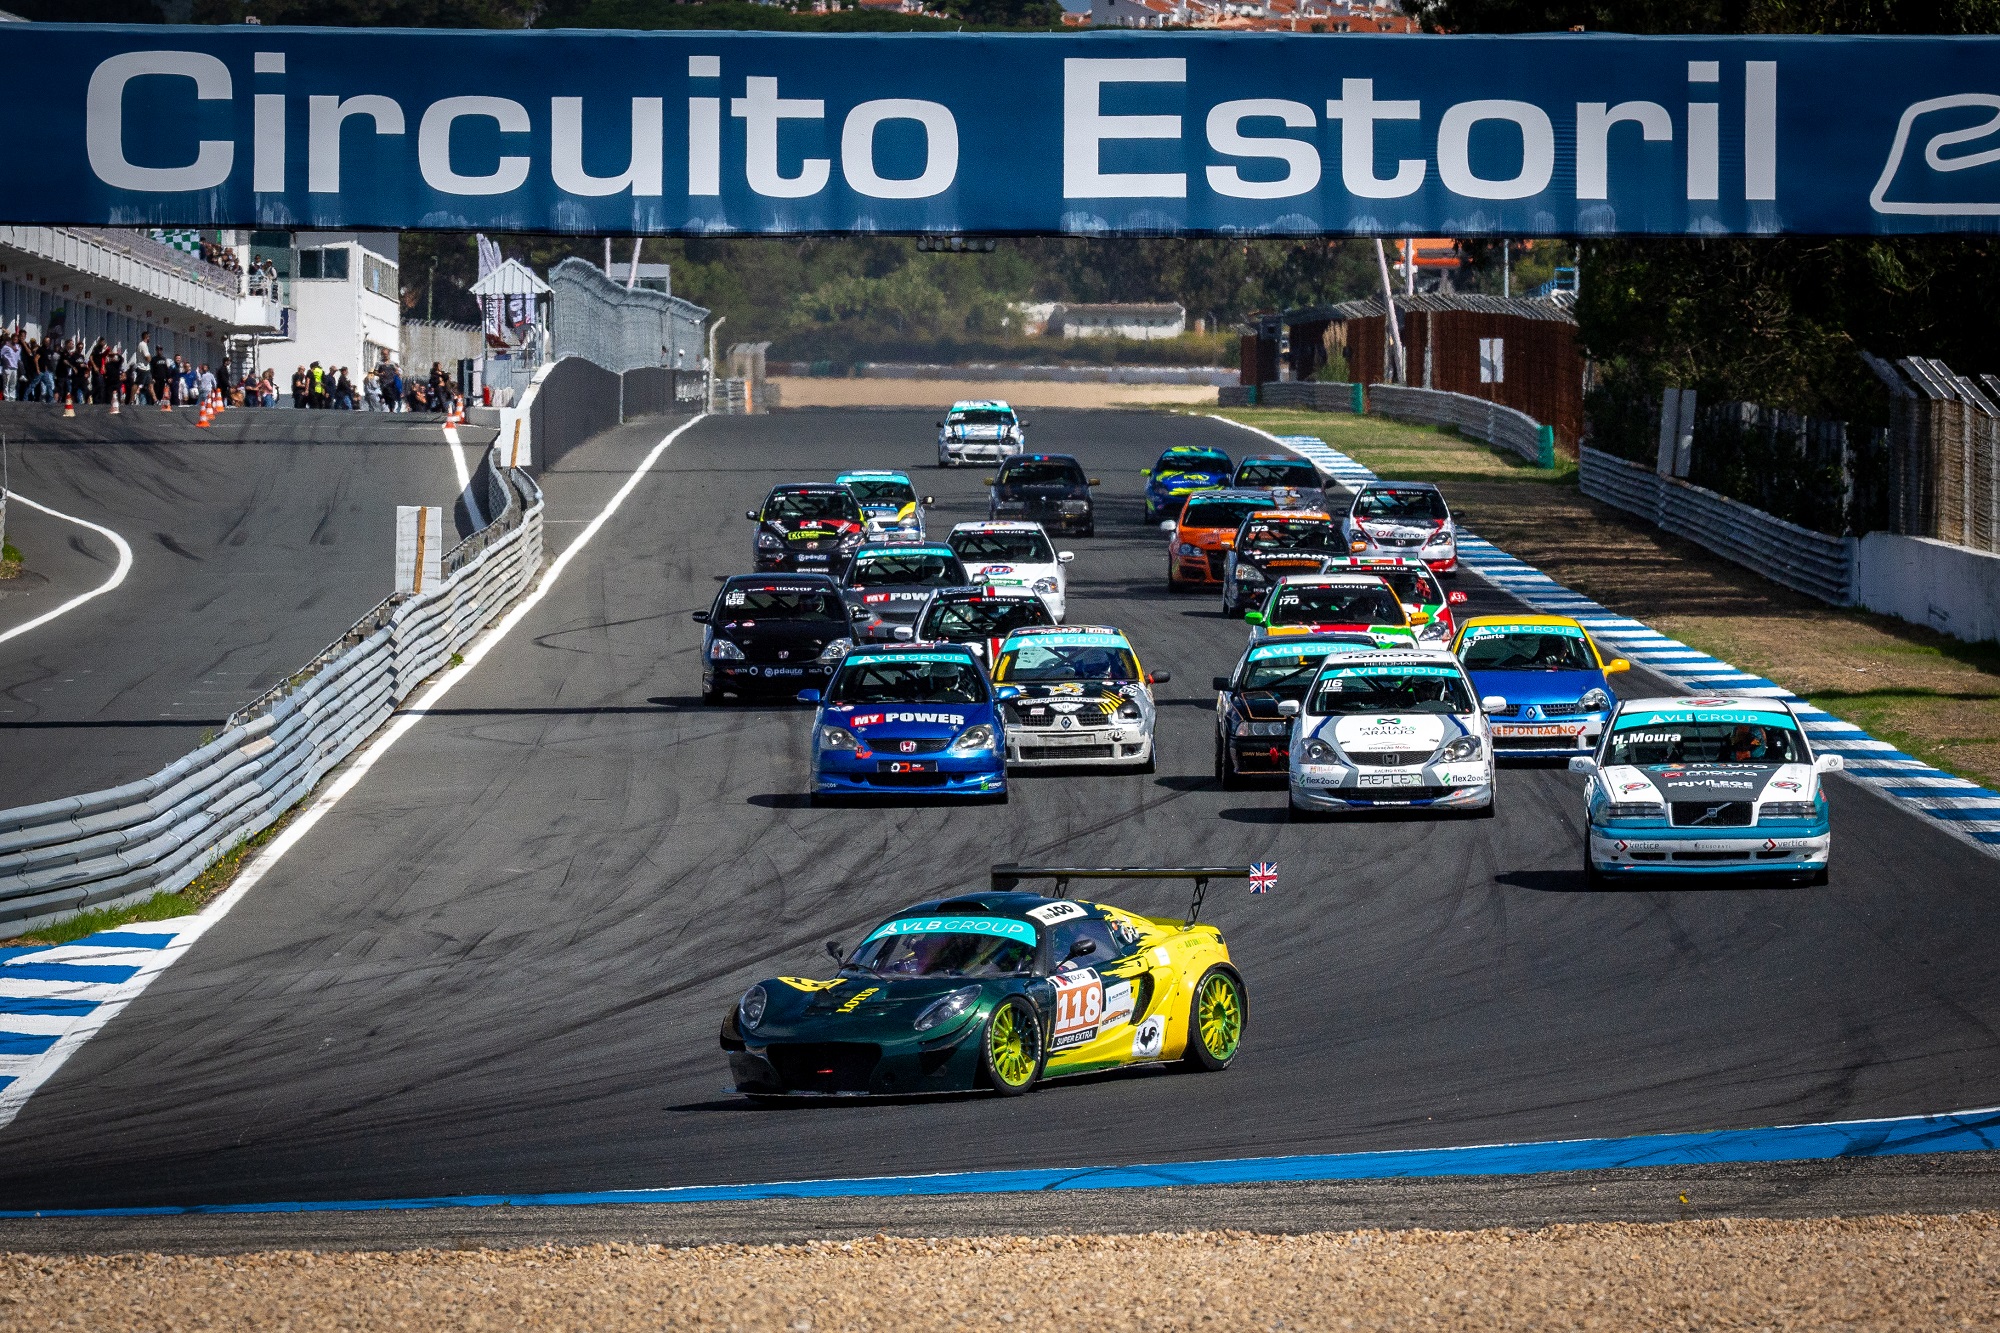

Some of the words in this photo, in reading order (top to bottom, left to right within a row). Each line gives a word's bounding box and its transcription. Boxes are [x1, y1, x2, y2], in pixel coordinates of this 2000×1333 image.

[87, 51, 958, 198] Circuito
[1064, 58, 1776, 199] Estoril
[726, 598, 744, 606] 166
[1279, 597, 1299, 605] 170
[1491, 625, 1520, 633] VLB
[1522, 626, 1576, 634] GROUP
[1035, 637, 1064, 645] VLB
[1066, 636, 1120, 645] GROUP
[1473, 633, 1506, 641] Duarte
[1272, 647, 1302, 655] VLB
[1322, 679, 1343, 688] 116
[854, 714, 880, 726] MY
[885, 712, 964, 725] POWER
[1697, 713, 1758, 723] GROUP
[1491, 726, 1514, 735] KEEP
[1517, 726, 1533, 735] ON
[1537, 725, 1577, 735] RACING
[1612, 732, 1682, 745] H.Moura
[1359, 774, 1421, 785] REFLEX
[1667, 779, 1753, 788] PRIVILEGE
[902, 921, 940, 931] VLB
[944, 920, 1025, 934] GROUP
[835, 987, 880, 1013] LOTUS
[1056, 986, 1101, 1031] 118
[1056, 1034, 1075, 1046] SUPER
[1075, 1029, 1093, 1041] EXTRA
